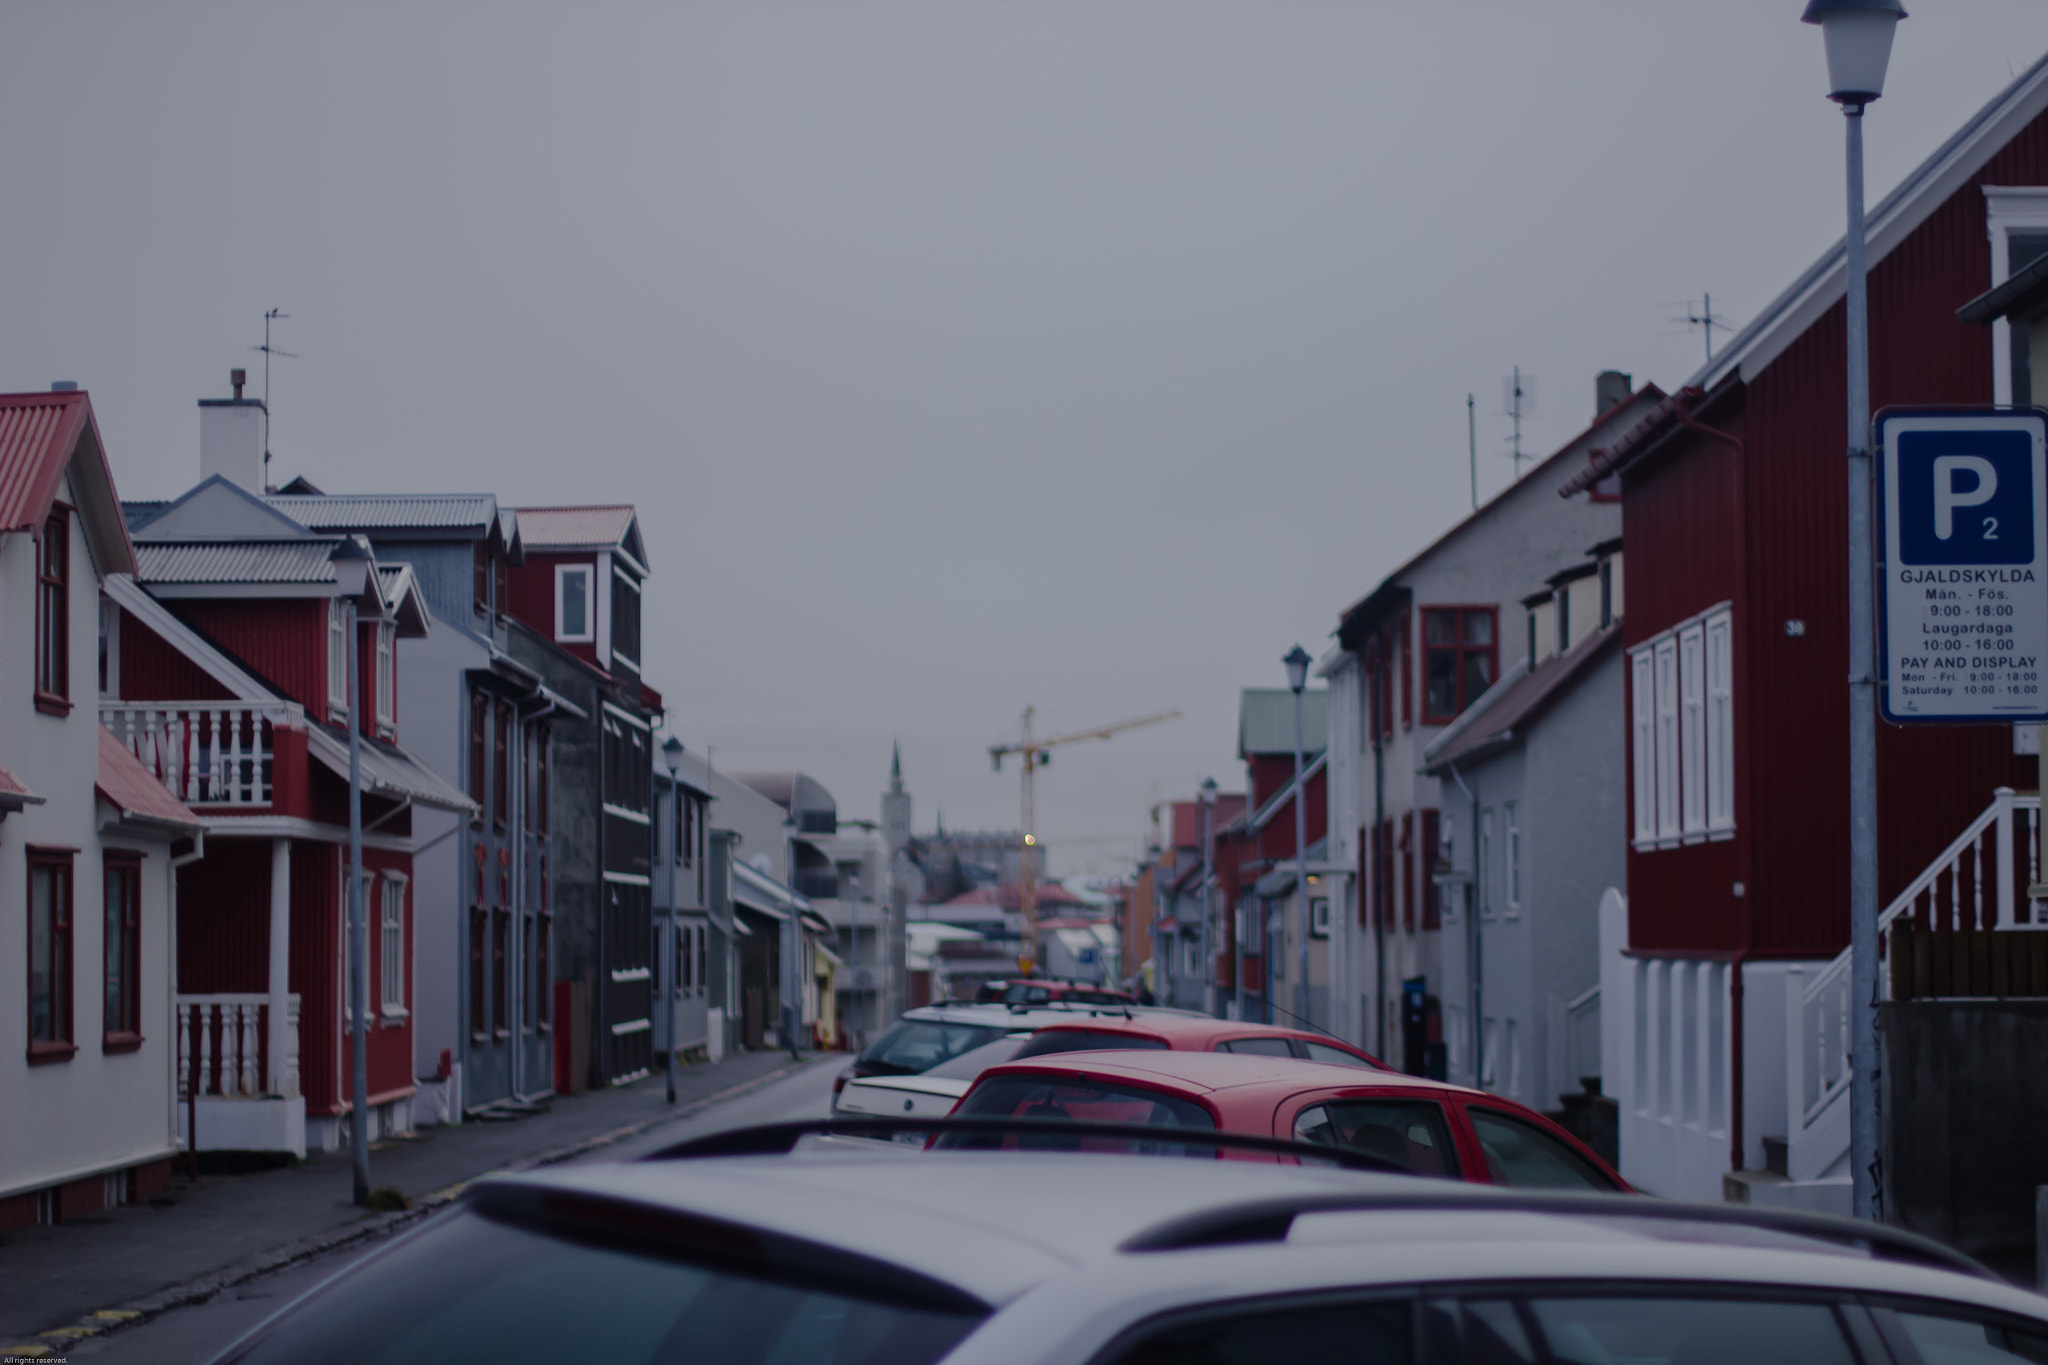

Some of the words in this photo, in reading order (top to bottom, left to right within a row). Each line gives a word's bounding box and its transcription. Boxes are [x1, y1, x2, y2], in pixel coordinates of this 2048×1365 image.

[1933, 455, 1998, 541] P
[1982, 516, 1999, 540] 2
[1900, 569, 2035, 583] GJALDSKYLDA
[1925, 588, 1961, 600] Mán.
[1978, 588, 2009, 600] Fös.
[1930, 604, 1961, 616] 9:00
[1975, 604, 2013, 616] 18:00
[1922, 622, 2013, 636] Laugardaga
[1923, 639, 1962, 651] 10:00
[1975, 638, 2014, 650] 16:00
[1901, 657, 1929, 669] PAY
[1934, 657, 1967, 669] AND
[1972, 656, 2037, 668] DISPLAY
[1901, 673, 1925, 682] Mon
[1969, 672, 1995, 682] 9:00
[2006, 672, 2037, 681] 18:00
[1902, 686, 1953, 696] Saturday
[1964, 685, 1995, 695] 10:00
[2007, 685, 2038, 694] 16:00
